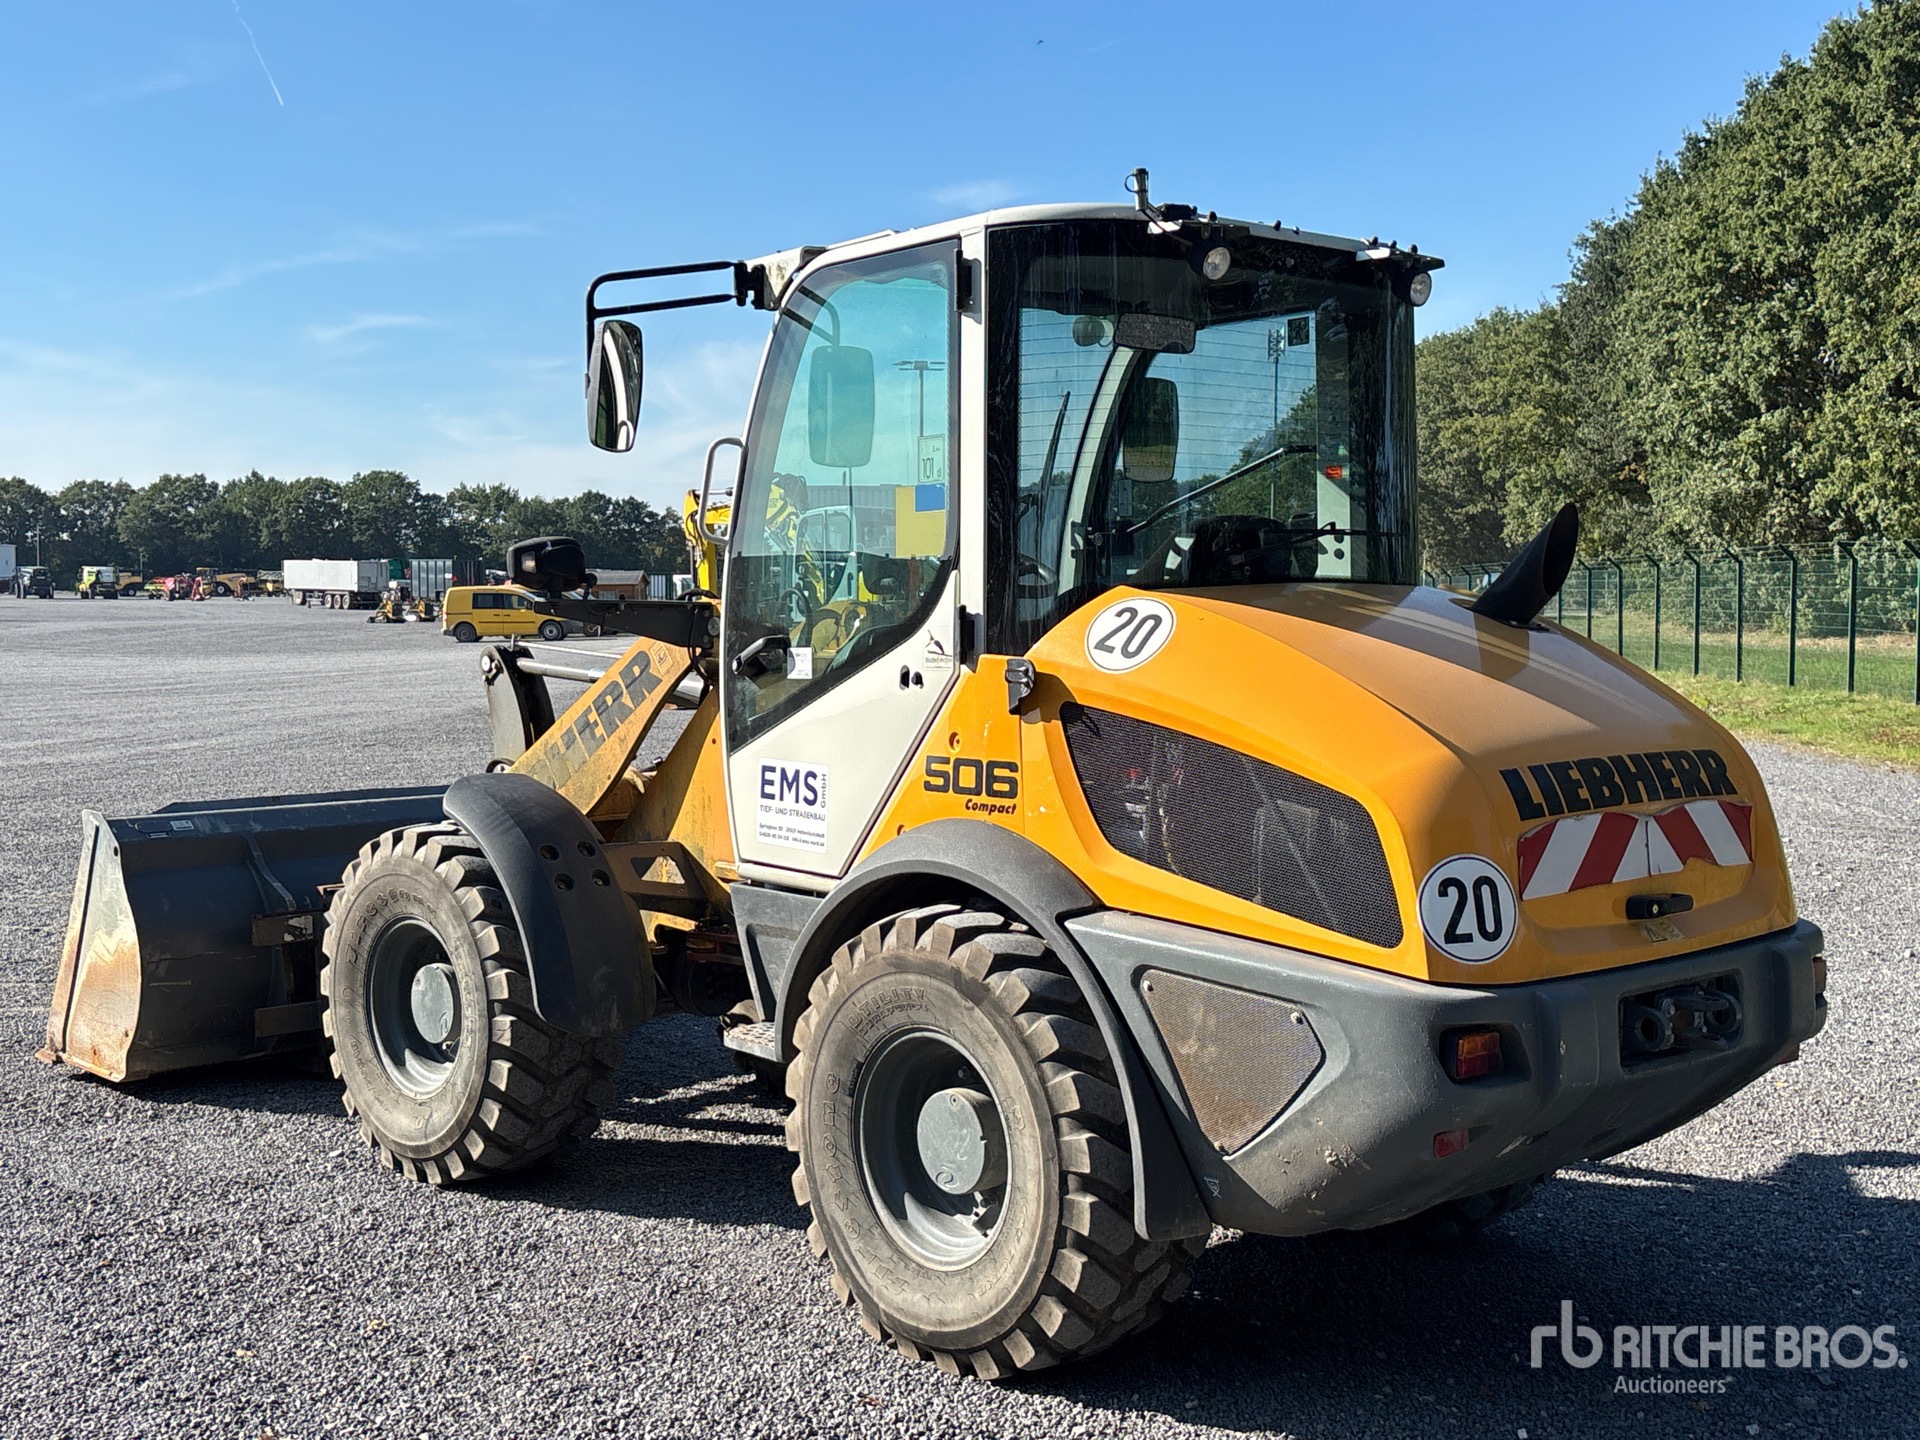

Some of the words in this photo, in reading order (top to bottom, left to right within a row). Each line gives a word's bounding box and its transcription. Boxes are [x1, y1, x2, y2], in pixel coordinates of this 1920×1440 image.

[922, 457, 934, 479] 101
[1093, 606, 1163, 659] 20
[760, 764, 819, 806] EMS
[923, 755, 1019, 799] 506
[1499, 749, 1738, 821] LIEBHERR
[775, 807, 788, 815] UND
[965, 799, 1017, 816] Compact
[1437, 875, 1503, 945] 20
[848, 986, 925, 1029] UTILITY
